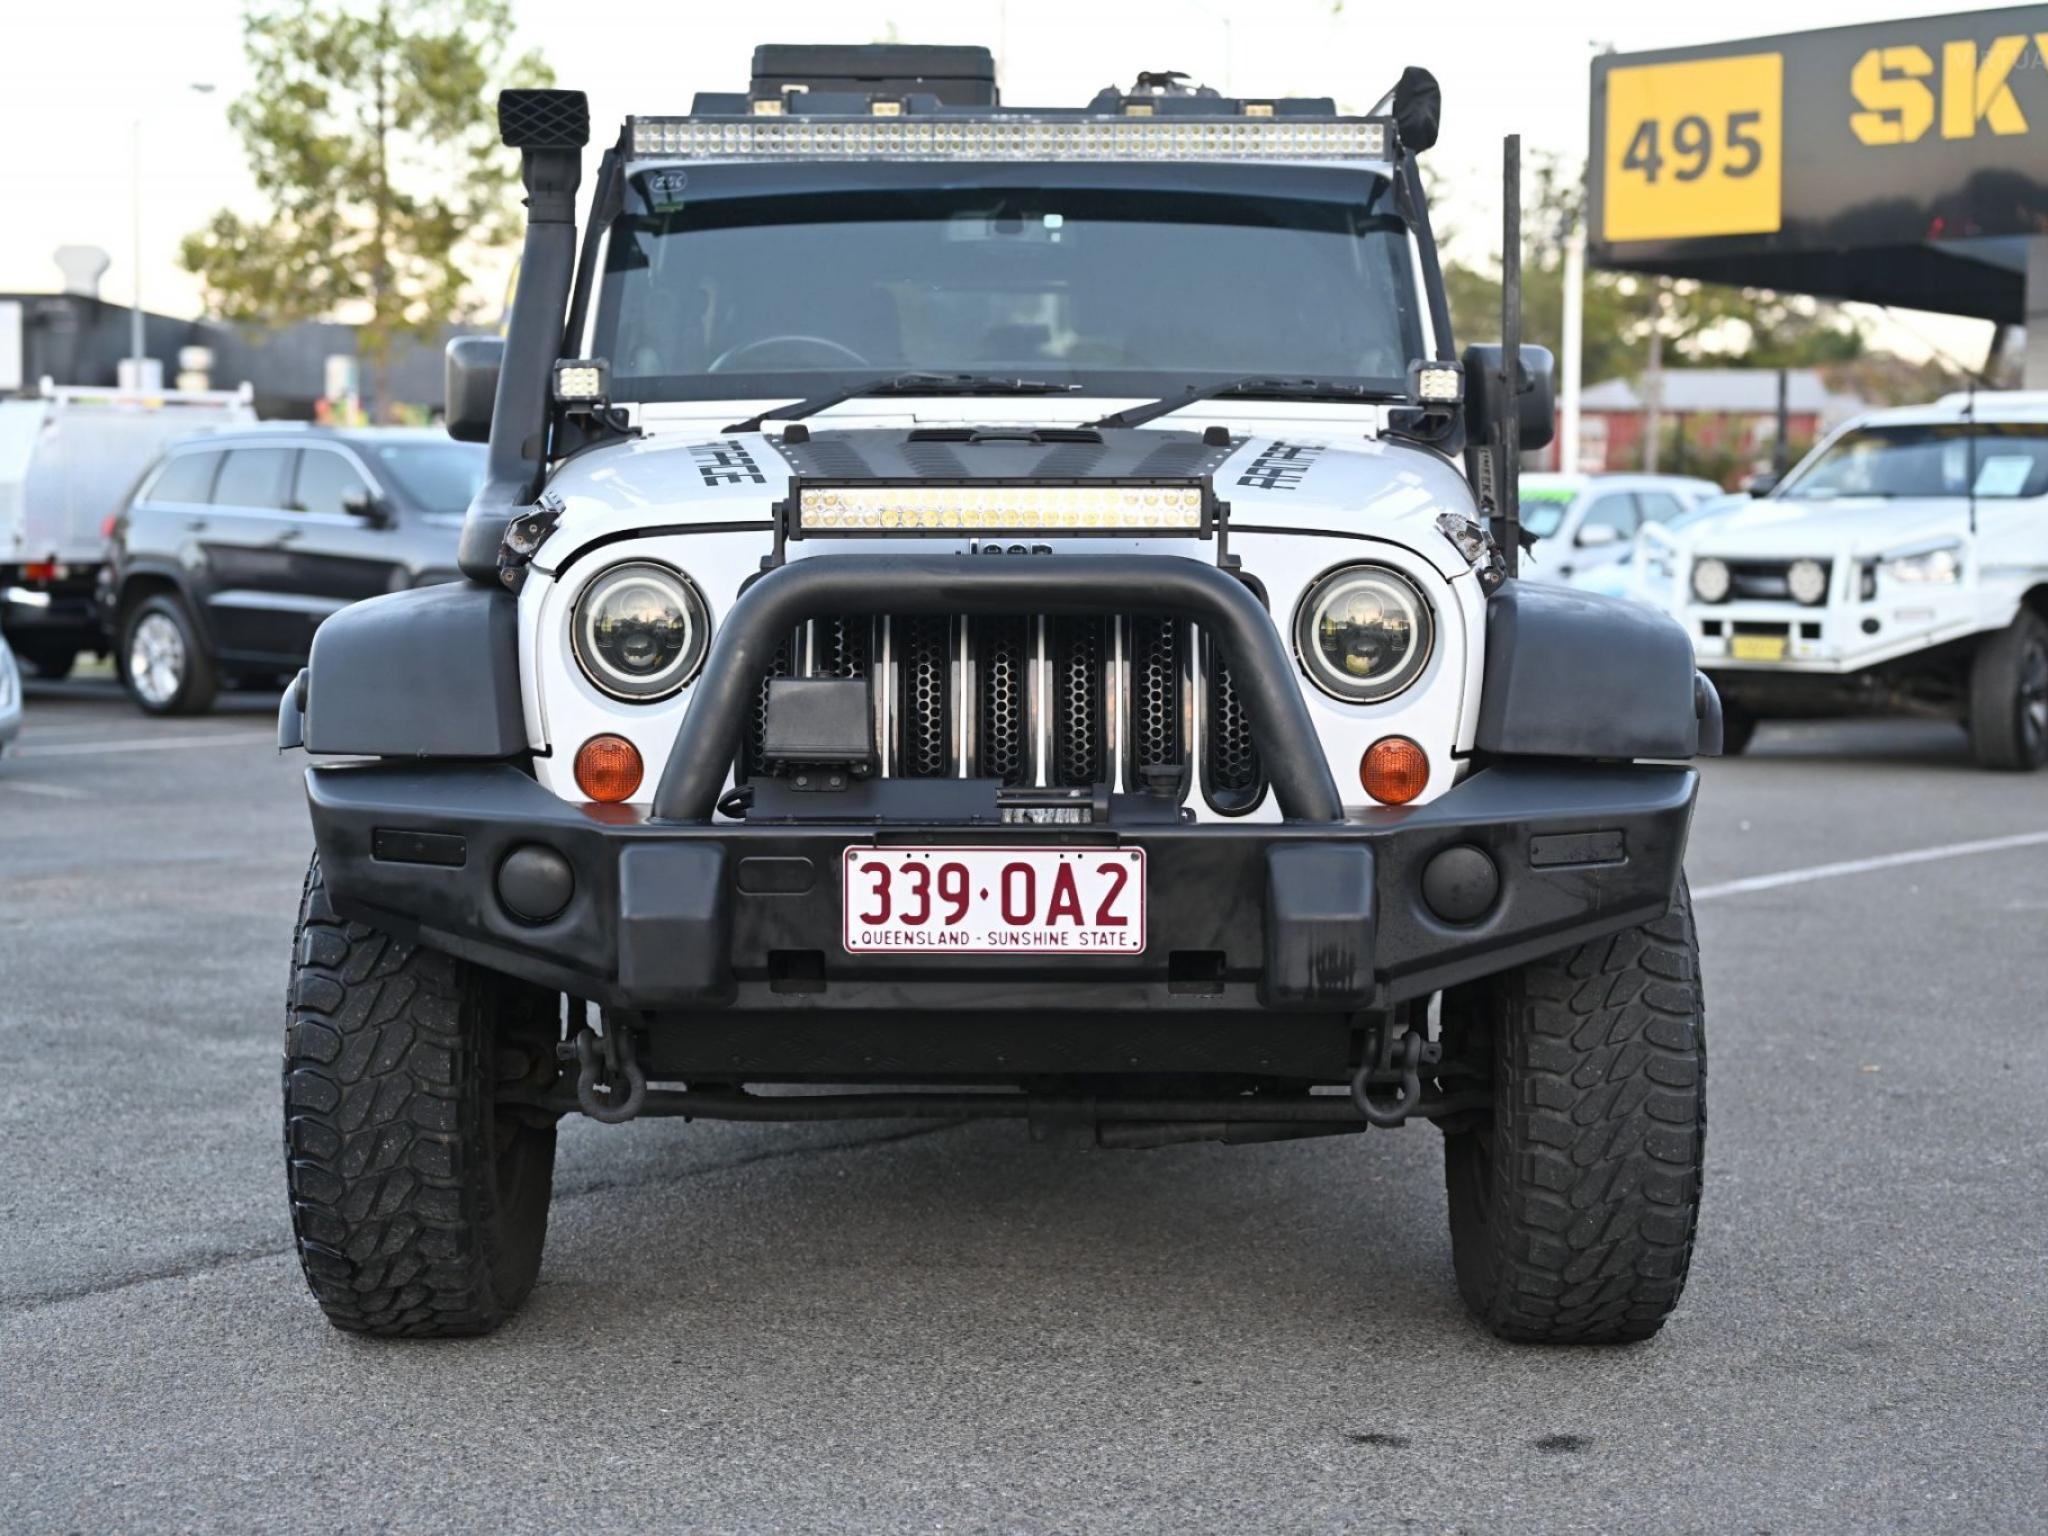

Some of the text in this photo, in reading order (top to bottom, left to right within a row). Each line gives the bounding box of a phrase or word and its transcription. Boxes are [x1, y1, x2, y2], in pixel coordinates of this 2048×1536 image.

[1849, 33, 2048, 146] SK
[1621, 110, 1763, 184] 495
[861, 931, 970, 946] QUEENSLAND
[988, 931, 1069, 946] SUNSHINE
[1079, 931, 1128, 946] STATE
